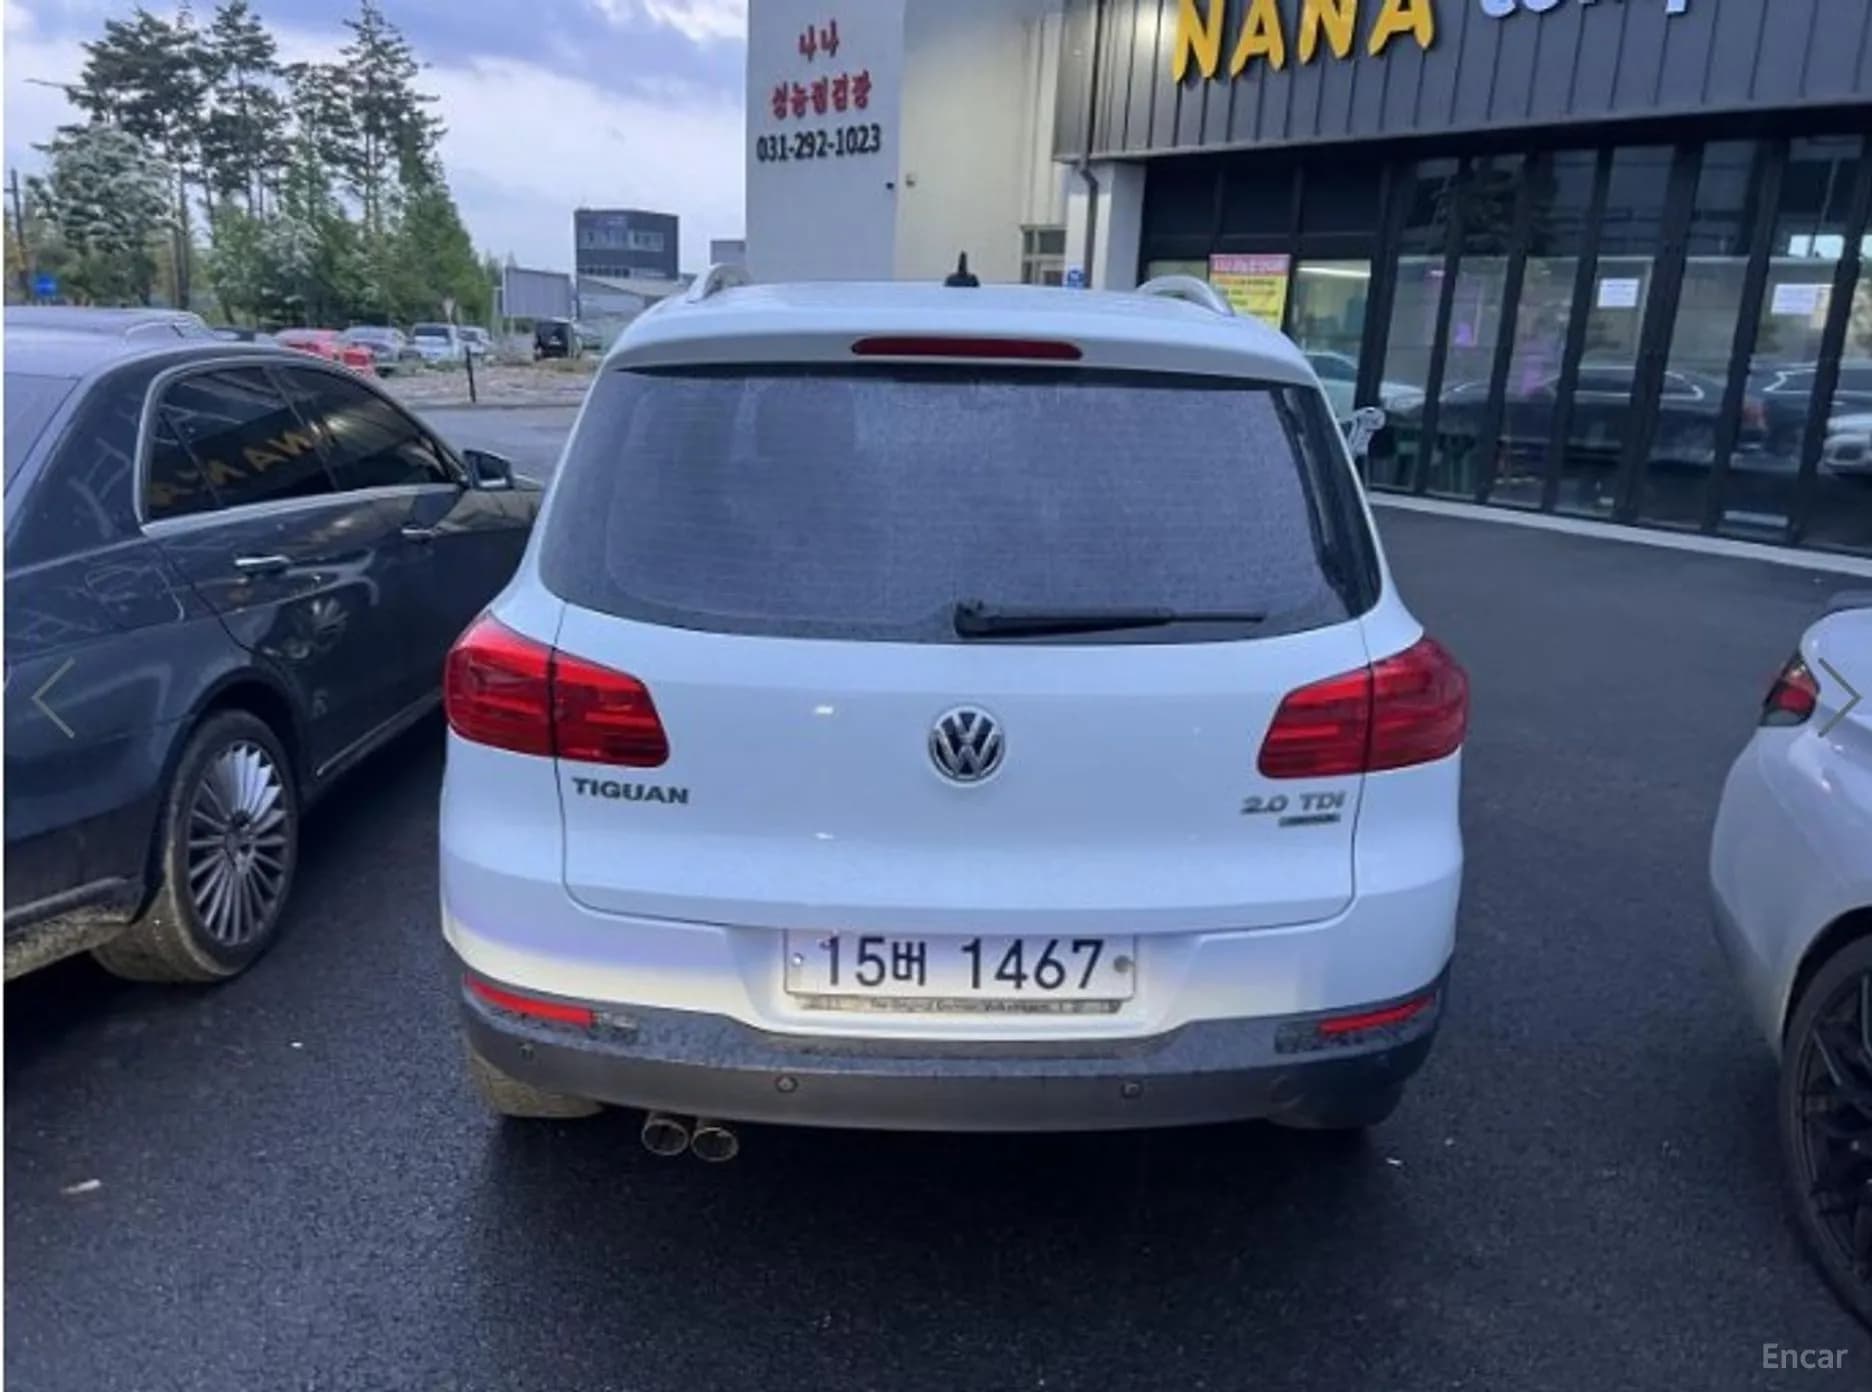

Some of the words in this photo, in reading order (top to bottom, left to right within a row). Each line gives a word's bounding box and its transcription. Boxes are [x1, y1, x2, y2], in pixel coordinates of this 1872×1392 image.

[799, 19, 840, 62] 나나
[1173, 0, 1434, 81] NANA
[772, 69, 872, 120] 성능점검장
[756, 123, 881, 161] 031-292-1023
[572, 777, 688, 804] TIGUAN
[1299, 790, 1346, 811] TDI
[819, 933, 927, 987] 15버
[961, 938, 1104, 989] 1467
